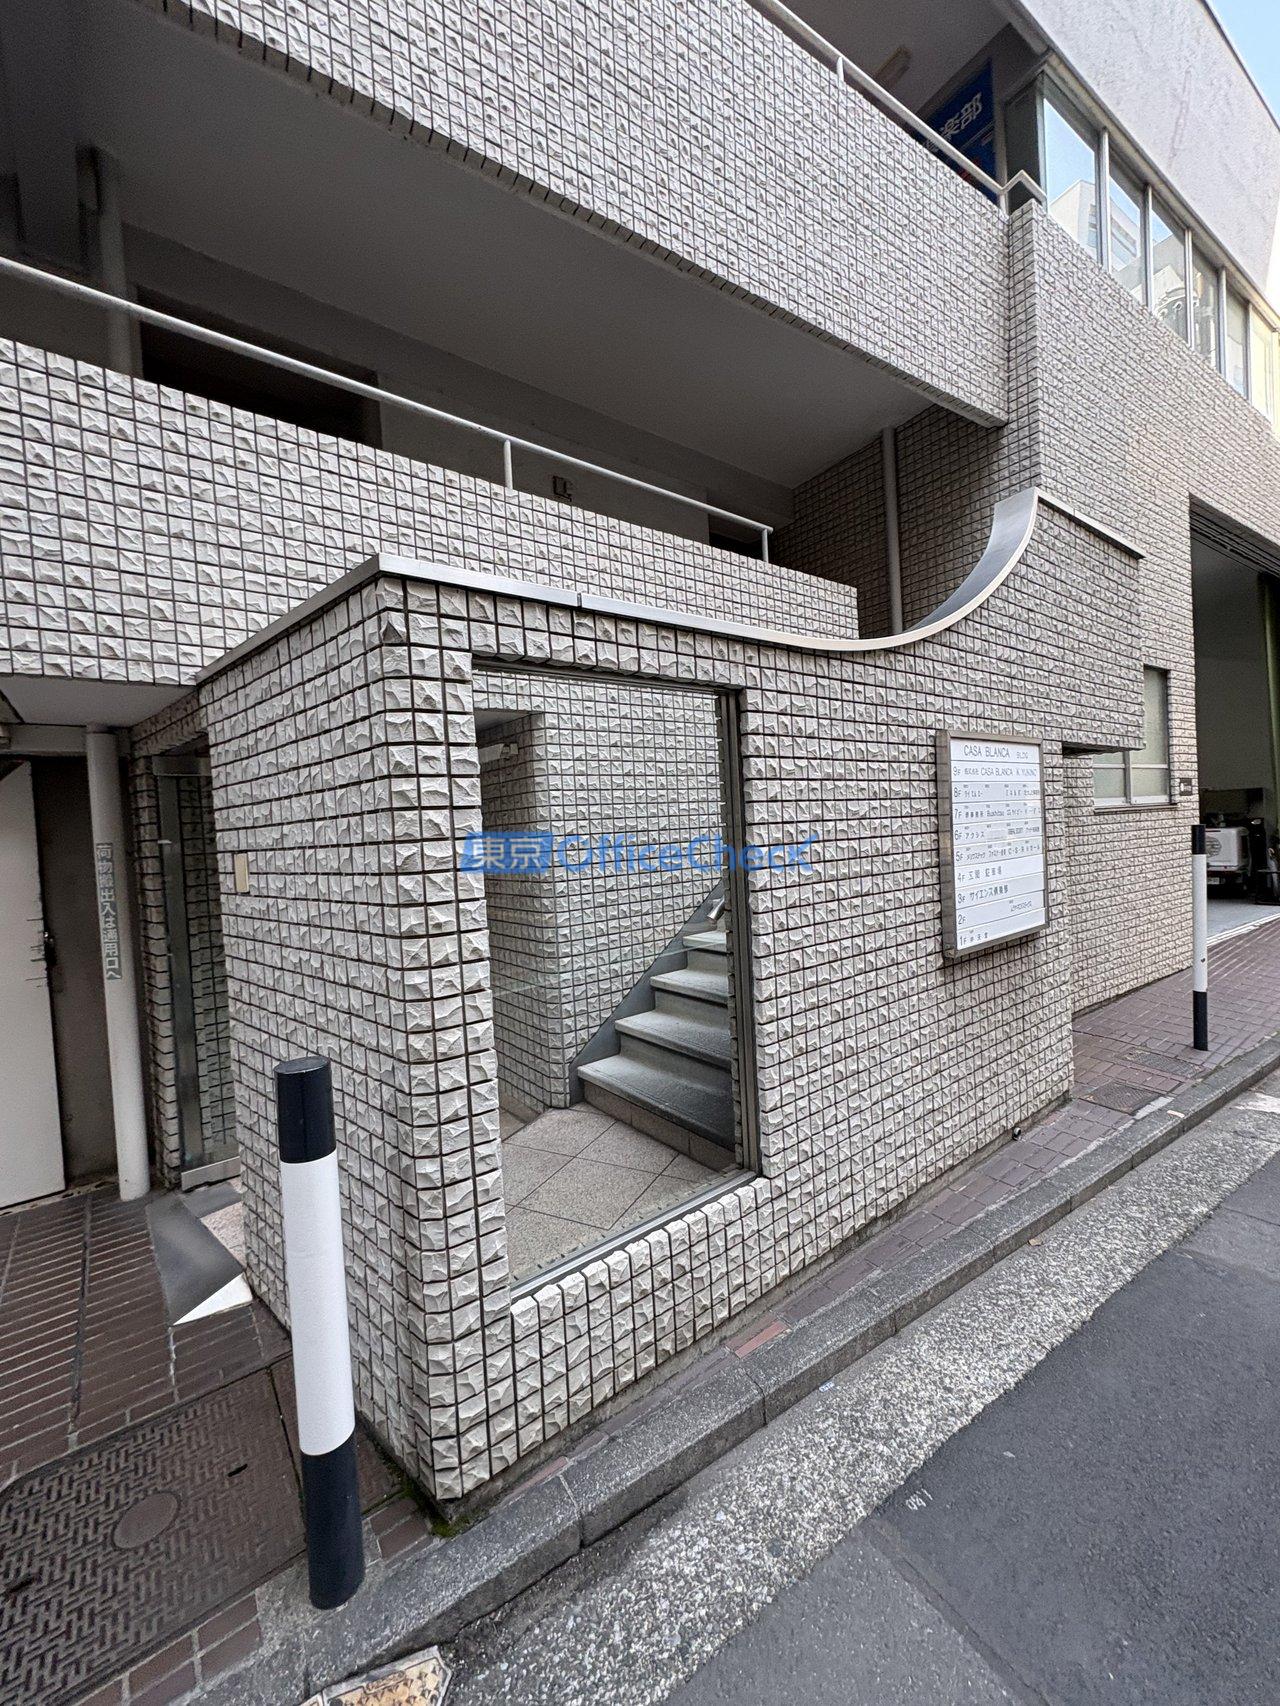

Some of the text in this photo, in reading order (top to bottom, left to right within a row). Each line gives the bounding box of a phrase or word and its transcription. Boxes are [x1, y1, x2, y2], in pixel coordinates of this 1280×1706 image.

[963, 744, 982, 757] CASA
[985, 746, 1011, 759] BLANCA
[953, 766, 961, 776] 9F
[980, 767, 994, 776] CASA
[995, 768, 1013, 777] BLANCA
[953, 787, 961, 798] 8F
[954, 808, 962, 819] 7F
[954, 829, 962, 841] 6F
[955, 851, 964, 861] 5F
[957, 873, 965, 882] 4F
[957, 893, 966, 904] 3F
[958, 914, 966, 925] 2F
[959, 935, 967, 946] 1F
